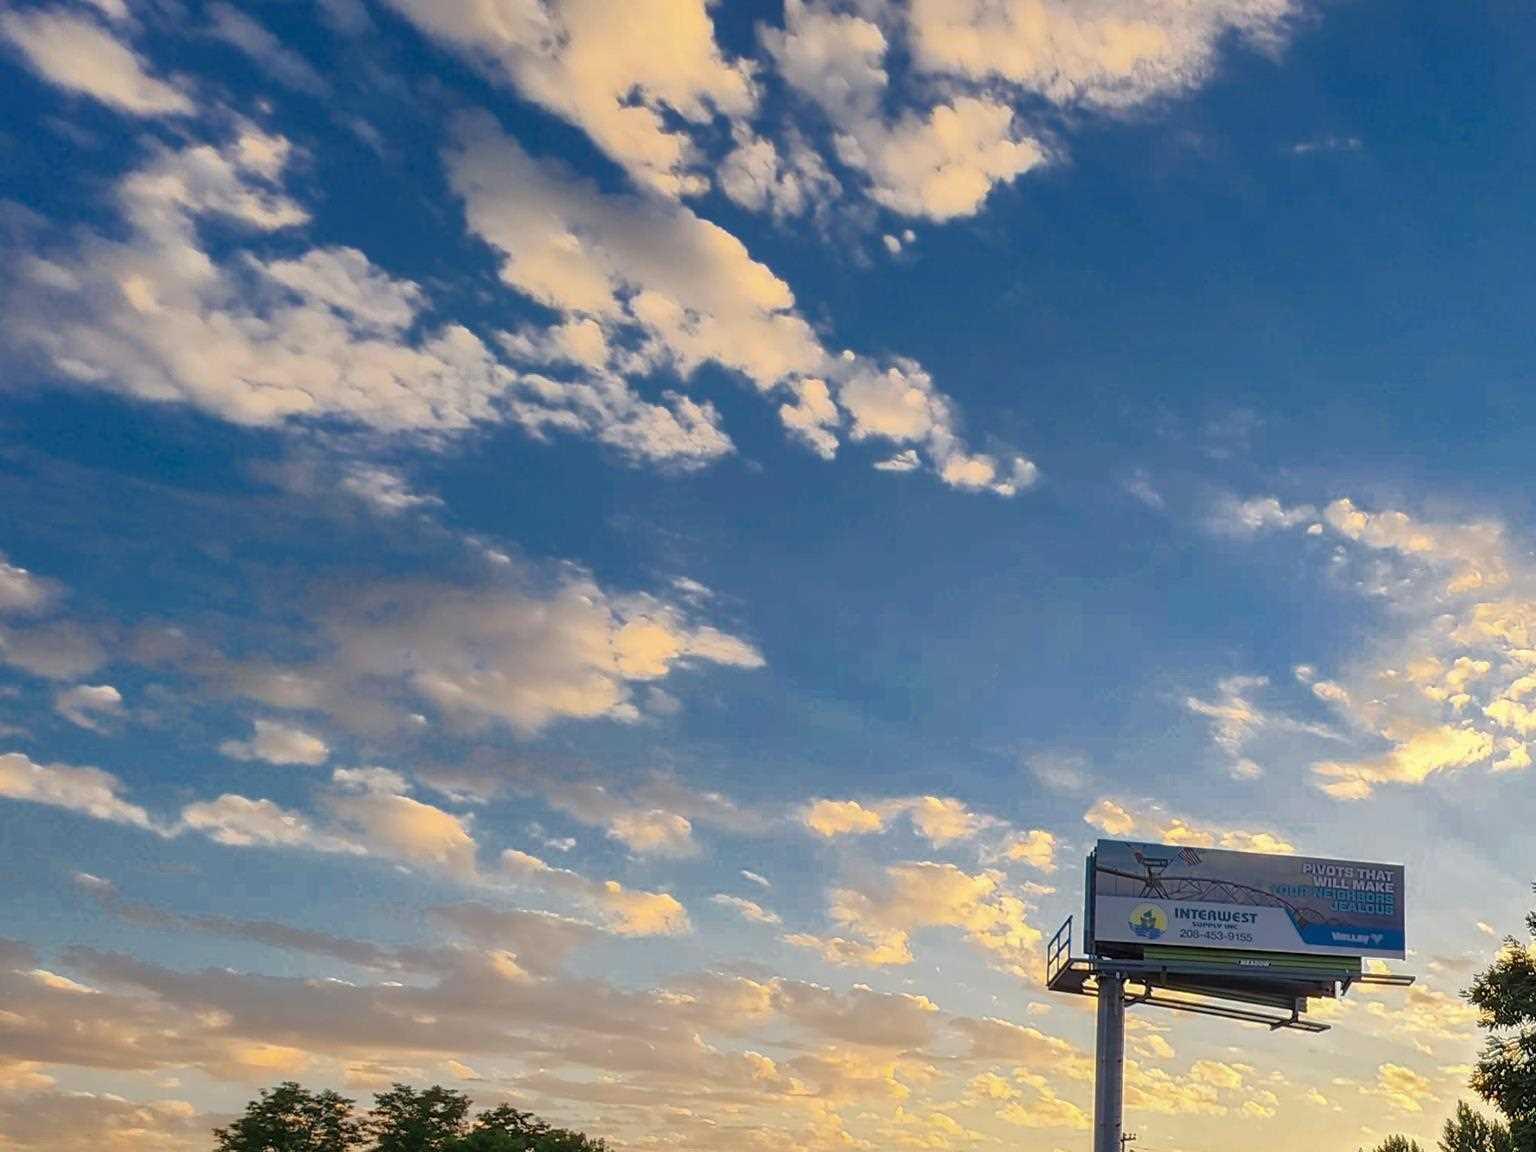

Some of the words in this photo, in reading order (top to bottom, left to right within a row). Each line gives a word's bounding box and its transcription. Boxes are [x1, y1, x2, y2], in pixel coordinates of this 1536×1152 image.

[1303, 863, 1353, 878] PIVOTS
[1358, 868, 1394, 881] THAT
[1313, 876, 1349, 889] WILL
[1352, 879, 1394, 893] MAKE
[1273, 885, 1309, 897] YOUR
[1312, 887, 1394, 905] NEIGHBORS
[1174, 907, 1258, 923] INTERWEST
[1328, 901, 1394, 915] JEALOUS
[1192, 920, 1222, 929] SUPPLY
[1179, 928, 1254, 942] 208-453-9155
